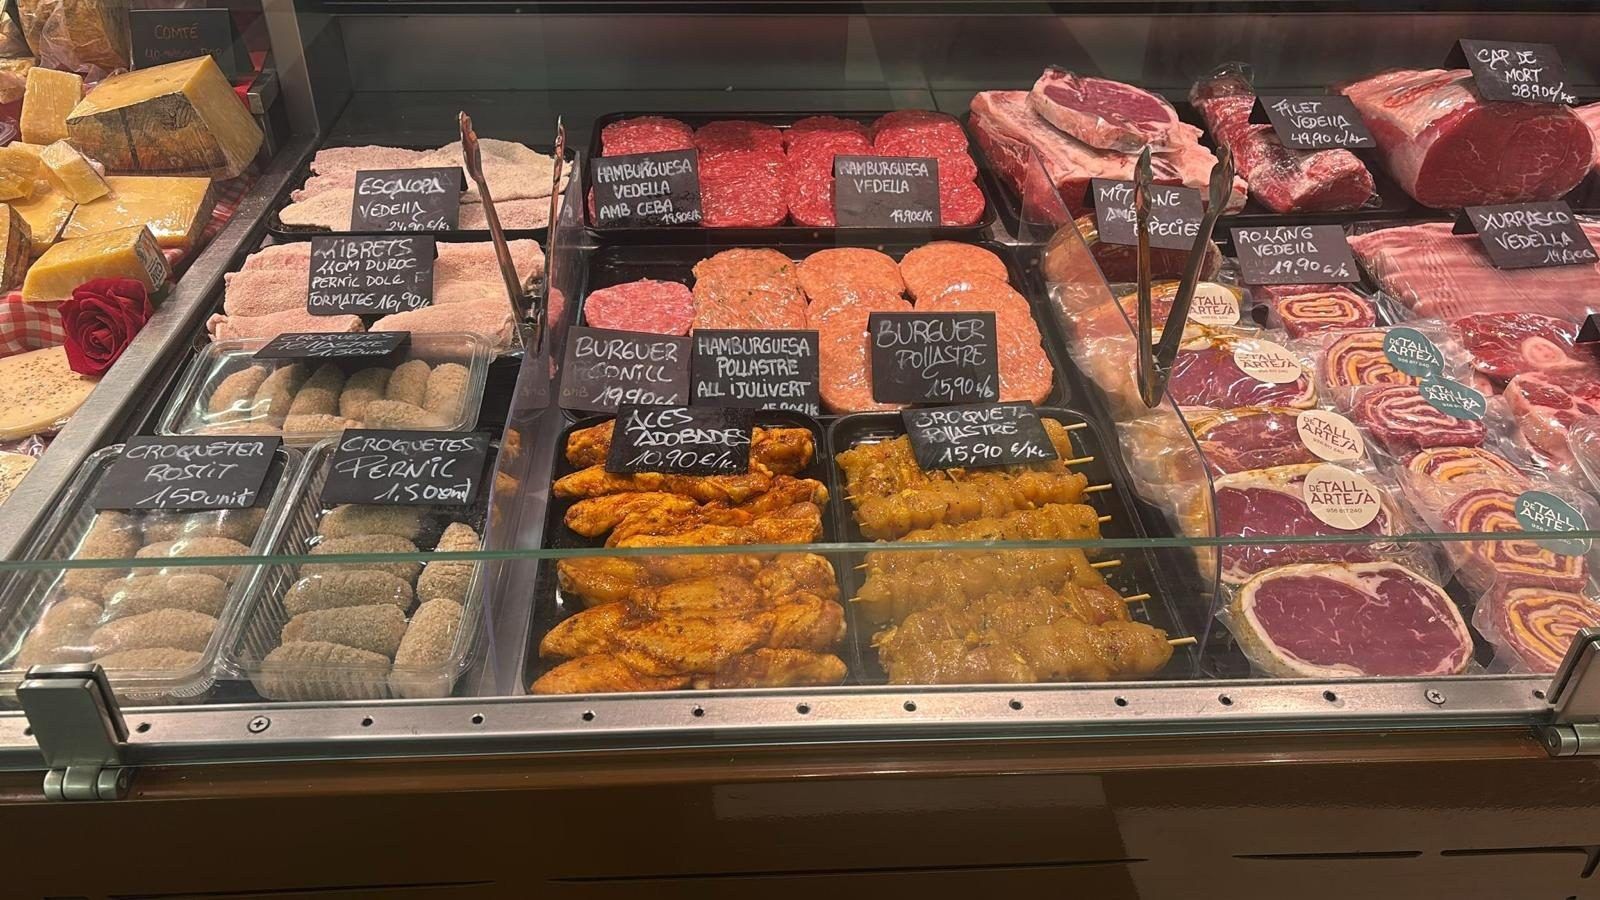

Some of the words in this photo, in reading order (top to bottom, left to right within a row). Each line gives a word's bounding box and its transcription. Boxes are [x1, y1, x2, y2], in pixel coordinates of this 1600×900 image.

[1516, 50, 1537, 65] DE
[1504, 67, 1543, 83] MORT
[597, 157, 693, 184] HAMBURGUESA
[613, 180, 671, 200] VEDELLA
[853, 178, 910, 194] VEDELLA
[600, 202, 632, 220] AMB
[636, 198, 673, 216] CEBA
[1494, 231, 1574, 250] VEDELLA
[366, 258, 417, 272] DUROC
[876, 318, 985, 348] BURGUER
[575, 335, 678, 363] BURGUER
[698, 335, 811, 357] HAMBURGUESA
[716, 356, 799, 378] POLLASTRE
[697, 380, 726, 398] ALL
[625, 407, 694, 435] ALES
[340, 436, 475, 455] CROQUETES
[633, 428, 751, 447] ADOBADES
[1311, 488, 1377, 505] ARTESÀ
